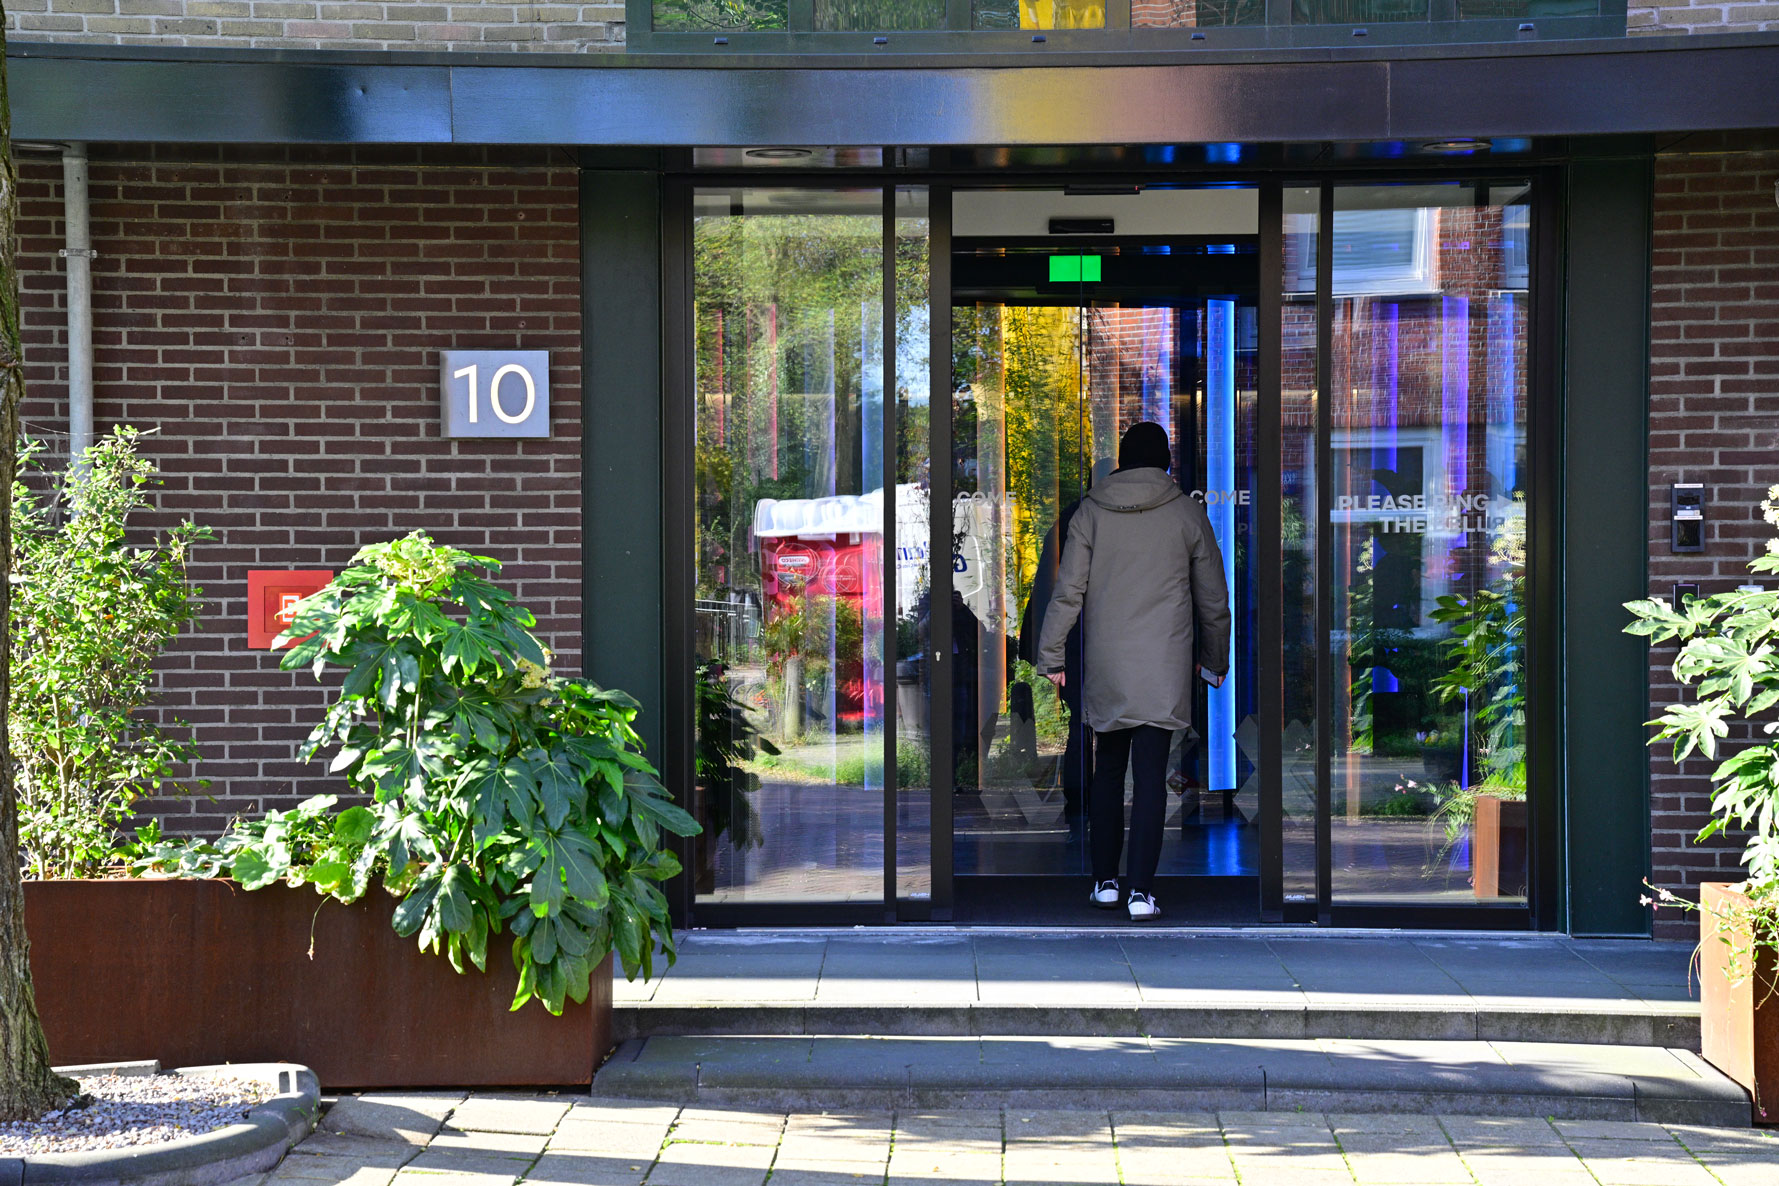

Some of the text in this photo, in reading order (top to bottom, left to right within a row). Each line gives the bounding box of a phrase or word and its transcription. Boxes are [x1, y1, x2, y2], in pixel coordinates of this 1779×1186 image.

[454, 364, 535, 424] 10
[957, 491, 1016, 506] COME
[1338, 493, 1490, 511] PLEASE RING
[1380, 516, 1426, 534] THE
[1434, 515, 1489, 533] BELL
